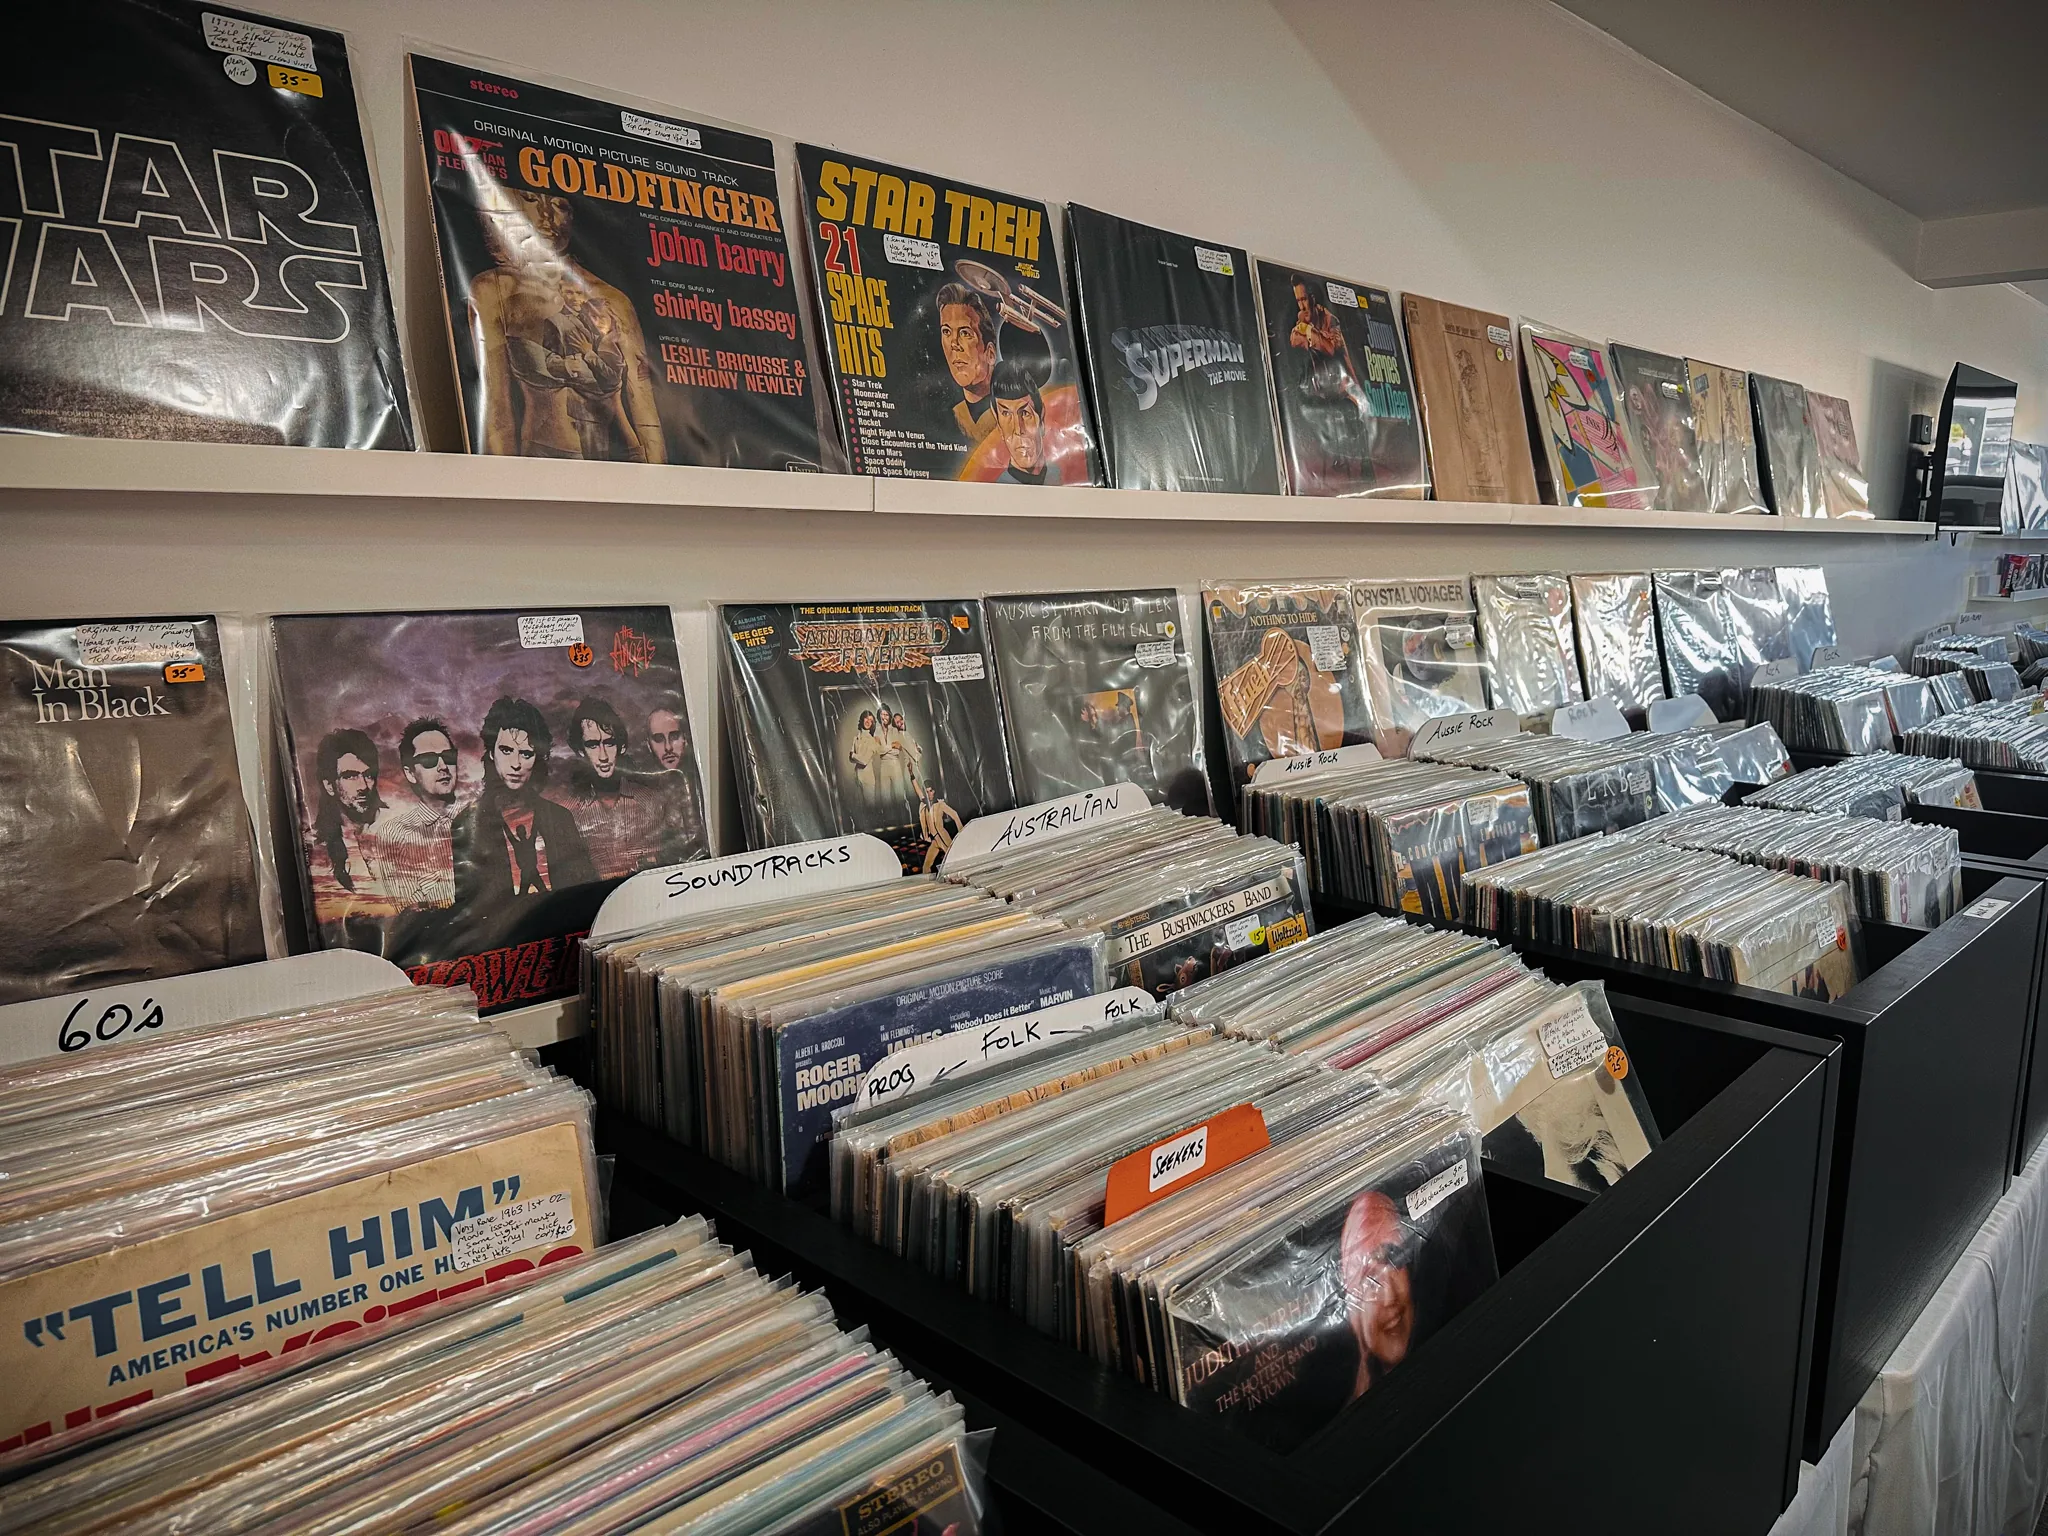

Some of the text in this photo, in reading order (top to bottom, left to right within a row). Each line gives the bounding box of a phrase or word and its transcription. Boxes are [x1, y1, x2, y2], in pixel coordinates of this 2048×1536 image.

[469, 78, 520, 100] stereo
[473, 119, 740, 187] ORIGINAL MOTION PICTURE SOUND TRACK
[482, 151, 506, 168] IAN
[0, 114, 363, 257] TAR
[518, 147, 782, 233] GOLDFINGER
[816, 160, 936, 239] STAR
[944, 189, 1042, 261] TREK
[639, 211, 773, 242] MUSIC COMPOSED ARRANGED AND CONDUCTED
[647, 222, 785, 288] john barry
[819, 221, 862, 276] 21
[650, 278, 667, 287] TITLE
[668, 281, 686, 290] SONG
[687, 284, 705, 293] SUNG
[826, 271, 894, 330] SPACE
[653, 288, 796, 340] shirley bassey
[658, 335, 680, 344] LYRICS
[834, 323, 887, 378] HITS
[1365, 313, 1397, 358] Jimmy
[660, 343, 807, 378] LESLIE BRICUSSE &
[1119, 335, 1245, 411] SUPERMAN
[1364, 345, 1401, 385] Barnes
[666, 364, 804, 397] ANTHONY NEWLEY
[852, 379, 883, 390] Star Trek
[1208, 370, 1247, 386] THE MOVIE
[853, 388, 889, 400] Moonraker
[855, 399, 896, 410] Logan's Run
[1385, 382, 1411, 426] Deep
[856, 408, 889, 419] Star Wars
[858, 418, 882, 428] Rocket
[859, 427, 926, 440] Night Flight to Venus
[860, 437, 968, 452] Close Encounters of the Third Kind
[862, 447, 903, 457] Life on Mars
[864, 456, 906, 469] Space Oddity
[865, 466, 930, 479] 2001 Space Odyssey
[799, 605, 922, 615] THE ORIGINAL MOVIE SOUND TRACK
[1355, 584, 1463, 607] CRYSTAL VOYAGER
[995, 600, 1059, 624] MUSIC BY
[1250, 611, 1317, 627] NOTHING TO HIDE
[732, 626, 775, 641] BEE GEES
[745, 636, 767, 647] HITS
[1031, 624, 1071, 641] FROM
[1075, 623, 1098, 640] THE
[1101, 622, 1126, 638] FILM
[838, 647, 908, 669] FEVER
[32, 658, 111, 693] Man
[32, 685, 172, 724] In Black
[1426, 721, 1464, 745] AUSSIE
[1285, 756, 1313, 773] AUSSIE
[990, 789, 1120, 852] AUSTRALIAN
[665, 846, 851, 898] SOUNDTRACKS
[1124, 931, 1152, 954] THE
[1161, 900, 1236, 940] BUSHWACKERS
[1242, 886, 1272, 908] BAND
[1271, 922, 1303, 944] Waltzing
[896, 969, 1004, 1007] ORIGINAL MOTION PICTURE SCORE
[1040, 989, 1074, 1009] MARVIN
[57, 997, 165, 1053] 60's
[949, 1009, 971, 1021] Including
[983, 1010, 1003, 1023] Does
[1002, 1006, 1010, 1016] It
[794, 1035, 846, 1060] ALBERT BROCCOLI
[868, 996, 1143, 1098] PROG FOLK FOLK
[880, 1023, 915, 1043] IAN FLEMING'S
[795, 1053, 862, 1090] ROGER
[1152, 1137, 1205, 1179] SEEKERS
[454, 1223, 475, 1235] Very
[501, 1204, 523, 1220] 1963
[107, 1264, 425, 1387] AMERICA'S NUMBER ONE
[1184, 1338, 1251, 1391] JUDITH
[1254, 1342, 1280, 1372] AND
[1215, 1335, 1318, 1413] THE HOTTEST BAND
[1247, 1370, 1296, 1411] IN TOWN
[858, 1460, 946, 1520] STEREO
[857, 1517, 882, 1536] ALSO
